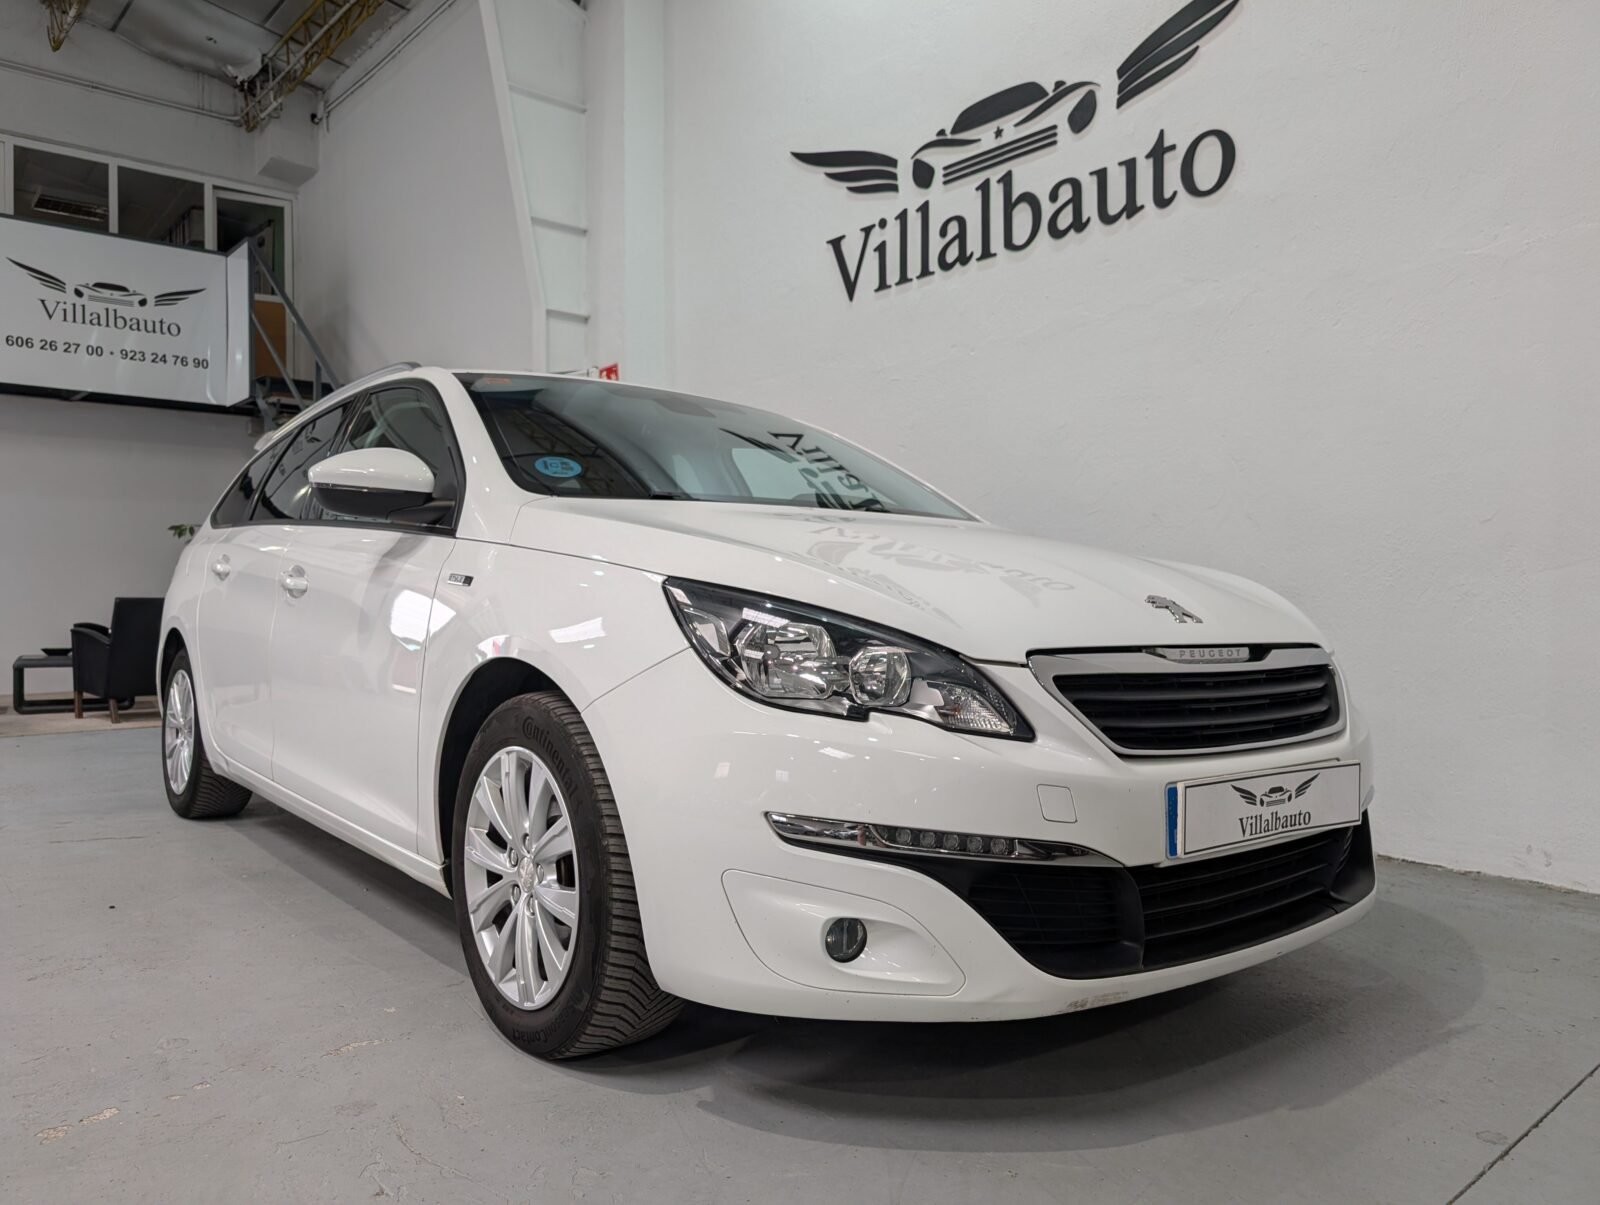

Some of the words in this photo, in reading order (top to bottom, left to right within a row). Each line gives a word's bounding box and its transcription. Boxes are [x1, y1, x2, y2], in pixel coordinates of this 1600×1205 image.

[826, 128, 1236, 302] Villalbauto
[38, 298, 181, 337] Villalbauto
[5, 335, 34, 349] 606
[39, 339, 58, 352] 26
[62, 341, 81, 354] 27
[86, 344, 104, 357] 00
[119, 348, 146, 362] 923
[150, 352, 167, 365] 24
[172, 354, 189, 367] 76
[192, 357, 209, 370] 90
[1179, 648, 1241, 658] PEUGEOT
[522, 716, 579, 799] Continental
[1238, 809, 1311, 838] Villalbauto
